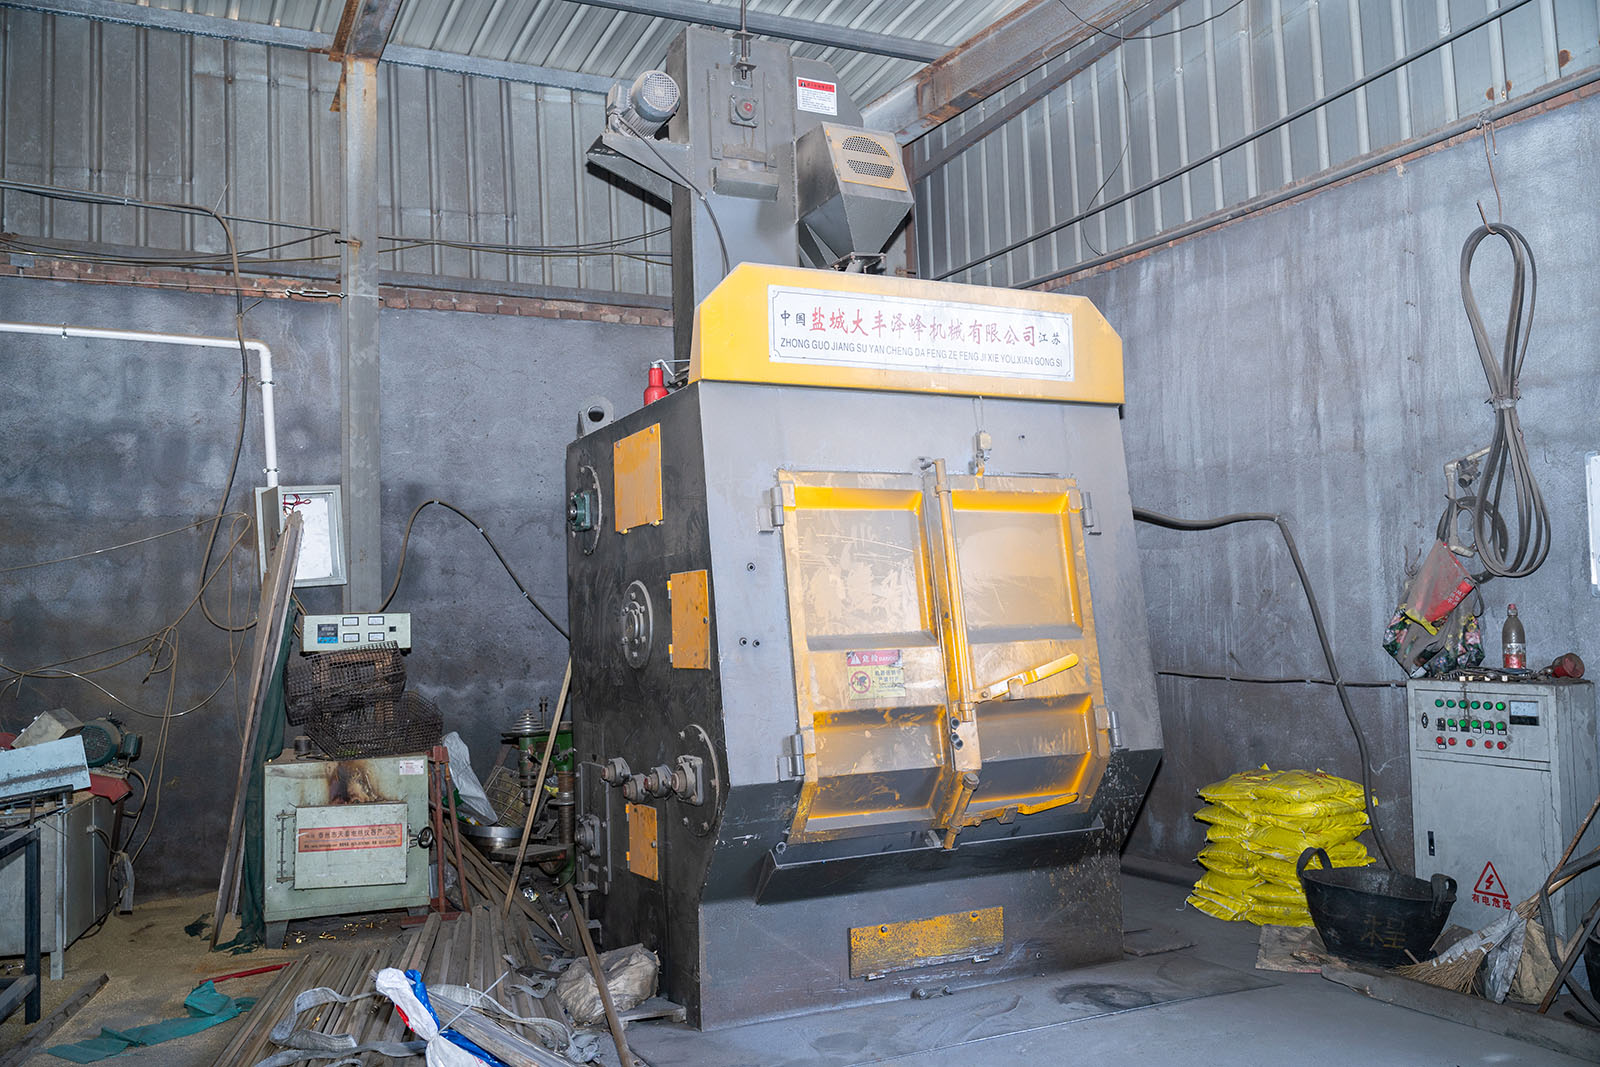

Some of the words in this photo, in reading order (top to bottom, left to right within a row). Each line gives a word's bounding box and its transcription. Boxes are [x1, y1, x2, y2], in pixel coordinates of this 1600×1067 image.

[780, 310, 806, 327] 中国
[809, 306, 1035, 347] 盐城大丰泽峰机械有限公司
[1038, 332, 1061, 346] 江苏
[780, 337, 810, 350] ZHONG
[811, 339, 830, 351] GUO
[831, 341, 855, 352] JIANG
[856, 343, 868, 353] SU
[869, 344, 885, 355] YAN
[886, 345, 914, 357] CHENG
[915, 347, 926, 357] DA
[926, 349, 947, 359] FENG
[948, 350, 958, 360] ZE
[959, 351, 979, 362] FENG
[980, 352, 987, 362] JI
[987, 353, 999, 363] XIE
[1034, 356, 1055, 367] GONG
[1055, 358, 1063, 368] SI
[1472, 893, 1512, 910] 有电危险
